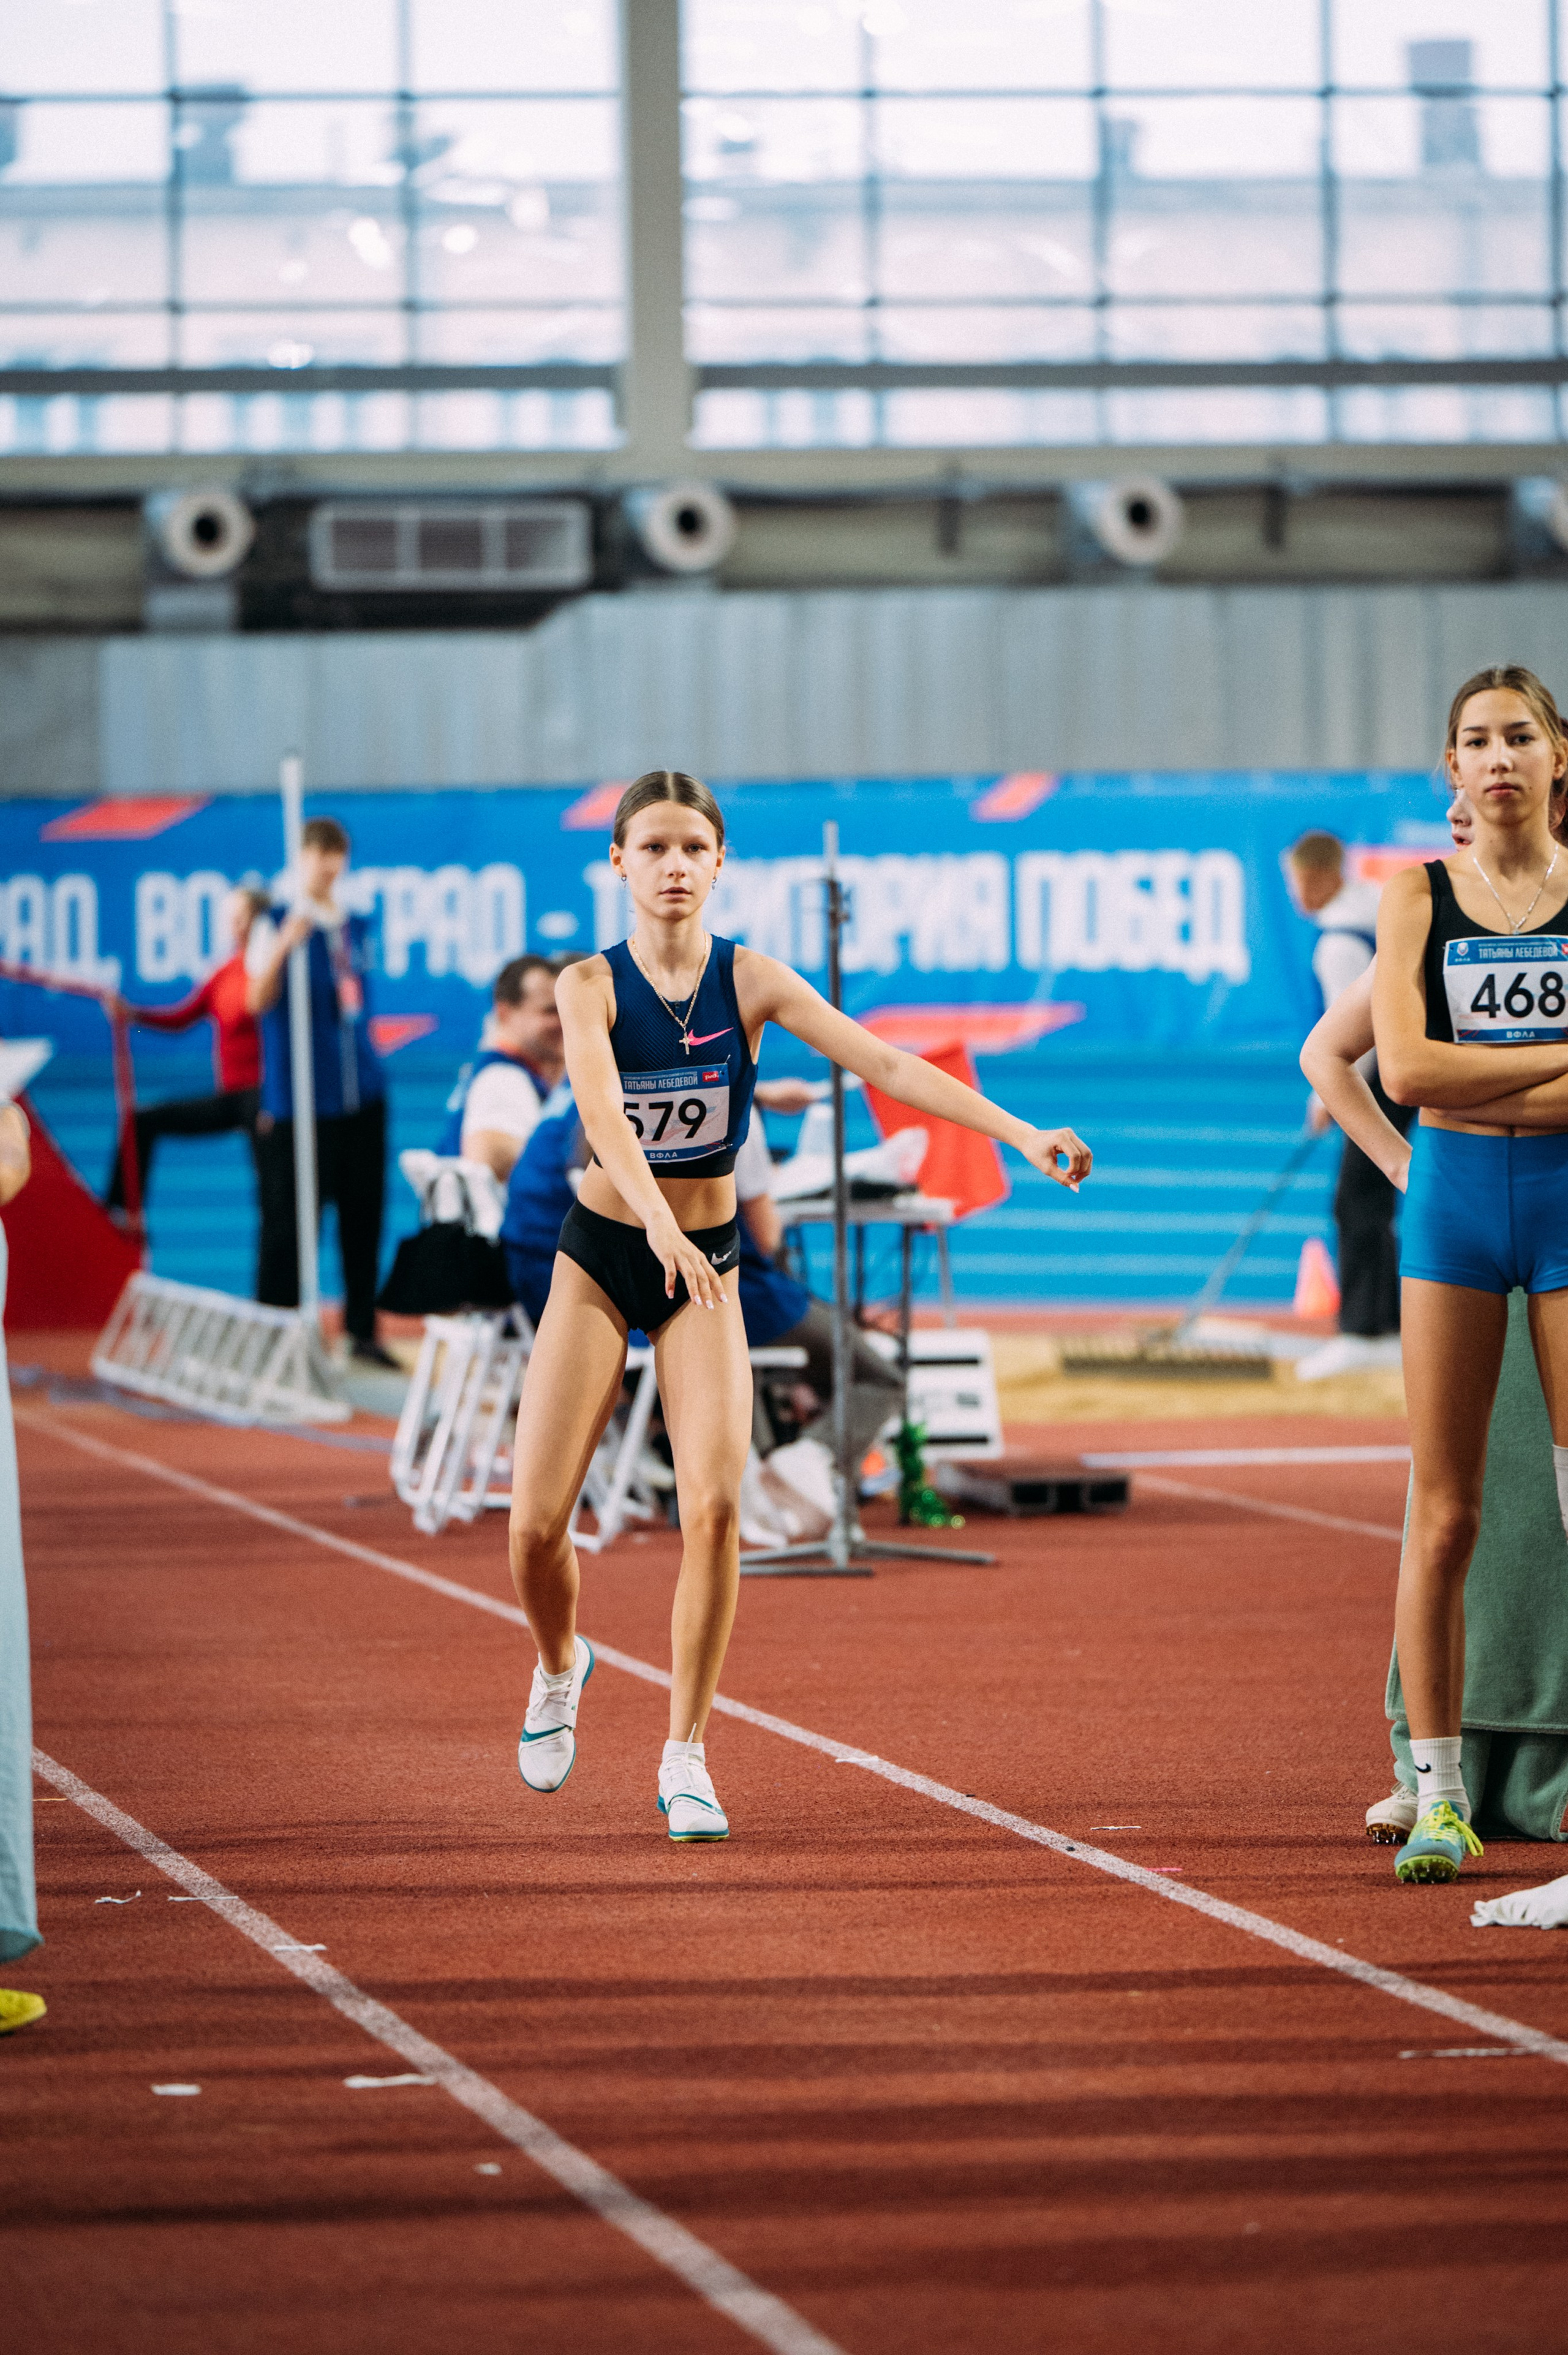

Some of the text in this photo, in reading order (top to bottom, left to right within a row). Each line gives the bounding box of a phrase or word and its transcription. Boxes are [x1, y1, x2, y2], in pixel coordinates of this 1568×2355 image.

[583, 850, 1009, 973] ТРИТОРИЯ
[1015, 848, 1251, 986] ПОБЕД
[1479, 947, 1514, 959] ТАТЬЯНЫ
[1515, 945, 1558, 959] ЛЕБЕДЕВОЙ
[1471, 971, 1566, 1018] 468
[624, 1079, 657, 1090] ТАТЬЯНЫ
[658, 1073, 698, 1089] ЛЕБЕДЕВОЙ
[624, 1098, 707, 1141] 579
